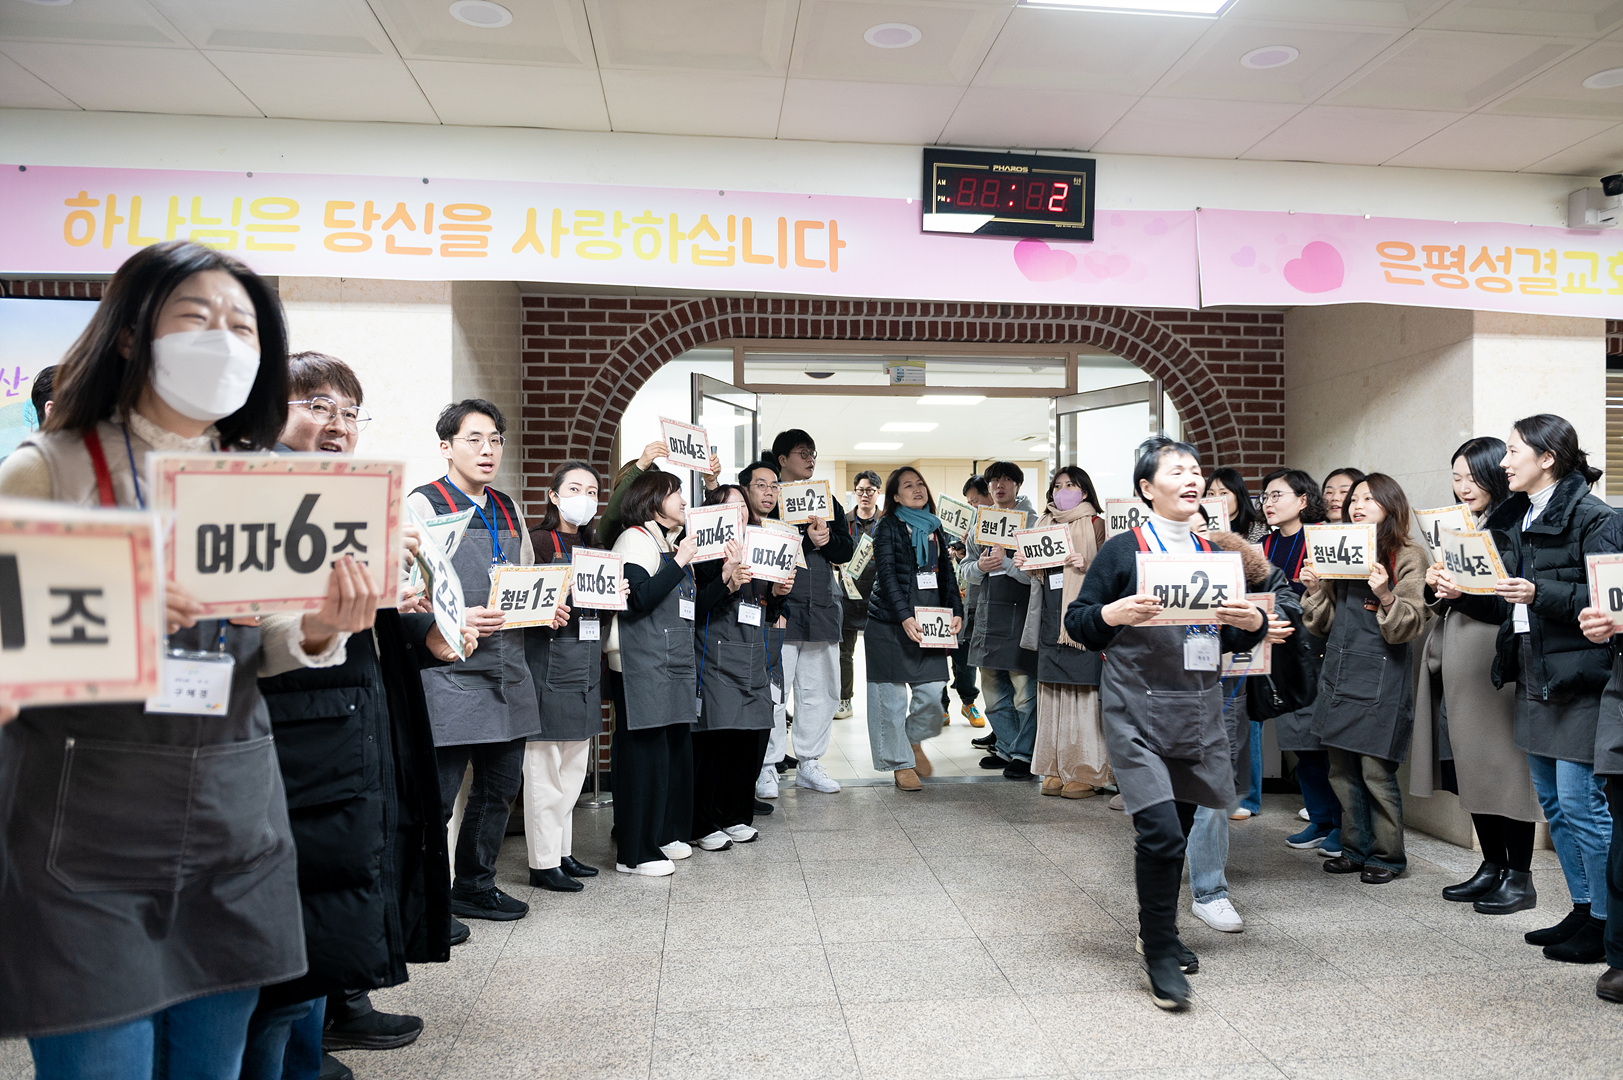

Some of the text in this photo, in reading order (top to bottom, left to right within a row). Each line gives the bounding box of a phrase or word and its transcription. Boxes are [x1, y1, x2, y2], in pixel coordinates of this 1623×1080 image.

[993, 165, 1029, 173] PHAROS
[63, 190, 847, 273] 하나님은 당신을 사랑하십니다
[669, 433, 706, 460] 여자4조
[785, 488, 826, 513] 청년2조
[196, 493, 368, 574] 여자6조
[696, 516, 735, 547] 여자4조
[940, 508, 969, 531] 남자1조
[981, 516, 1018, 538] 청년1조
[752, 543, 794, 571] 여자4조
[1023, 535, 1066, 559] 여자8조
[1313, 536, 1364, 565] 청년4조
[1445, 544, 1492, 577] 청년4조
[577, 564, 616, 595] 여자6조
[1153, 570, 1228, 610] 여자2조
[500, 577, 557, 611] 청년1조
[922, 616, 951, 638] 여자2조
